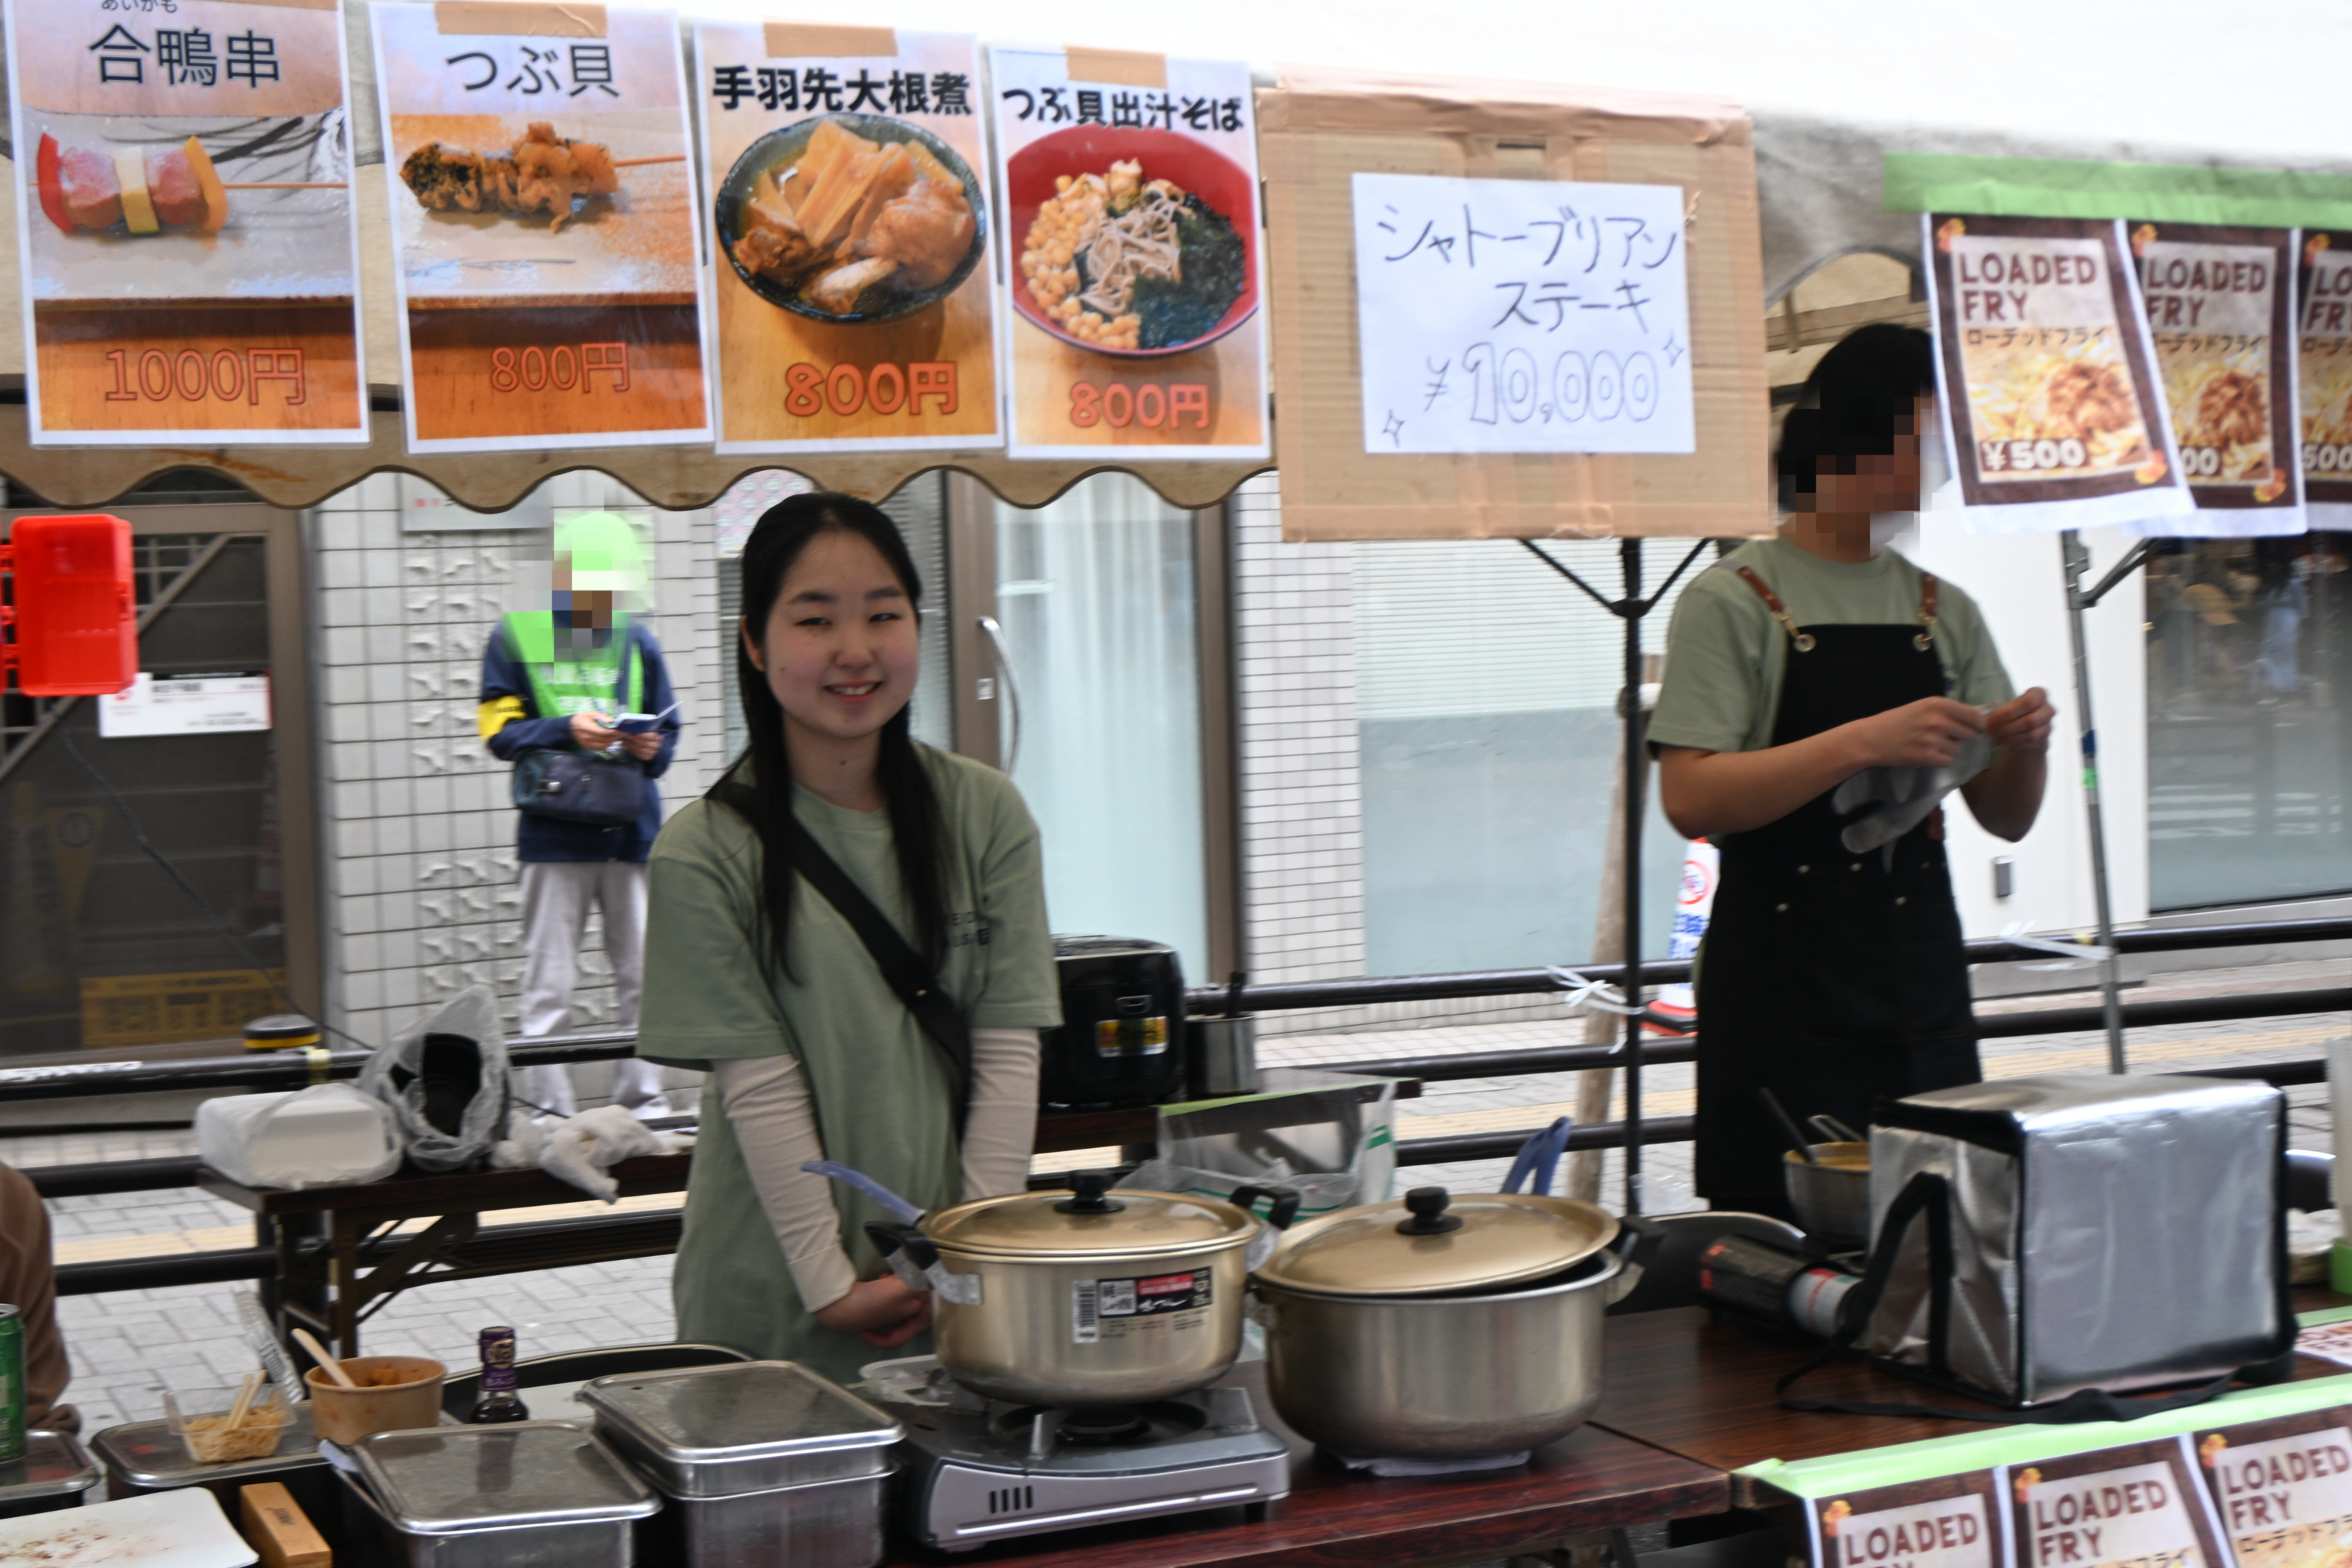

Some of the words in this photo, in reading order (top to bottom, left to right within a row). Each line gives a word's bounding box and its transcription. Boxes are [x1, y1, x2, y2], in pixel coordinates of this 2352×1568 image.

[89, 23, 281, 89] 合鴨串
[445, 43, 622, 99] つぶ貝
[712, 64, 973, 115] 手羽先大根煮
[1002, 86, 1245, 133] つぶ貝出汁そば
[1376, 203, 1677, 273] シャトーブリアン
[1959, 252, 2097, 286] LOADED
[2147, 257, 2267, 294] LOADED
[1491, 280, 1653, 334] ステーキ
[1962, 289, 2028, 321] FRY
[2145, 295, 2205, 328] FRY
[2306, 301, 2352, 332] FR
[1967, 326, 2107, 348] ローデッドフライ
[2154, 332, 2263, 354] ーデッドフライ
[104, 346, 306, 406] 1000円
[489, 342, 630, 394] 800円
[785, 360, 959, 418] 800円
[1069, 382, 1210, 429] 800円
[1981, 439, 2086, 471] ¥500
[2301, 444, 2352, 471] 500
[2223, 1445, 2350, 1495] LOADED
[2035, 1479, 2169, 1531] LOADED
[2230, 1490, 2292, 1531] FRY
[1844, 1512, 1979, 1566] LOADED
[2039, 1526, 2103, 1567] FRY
